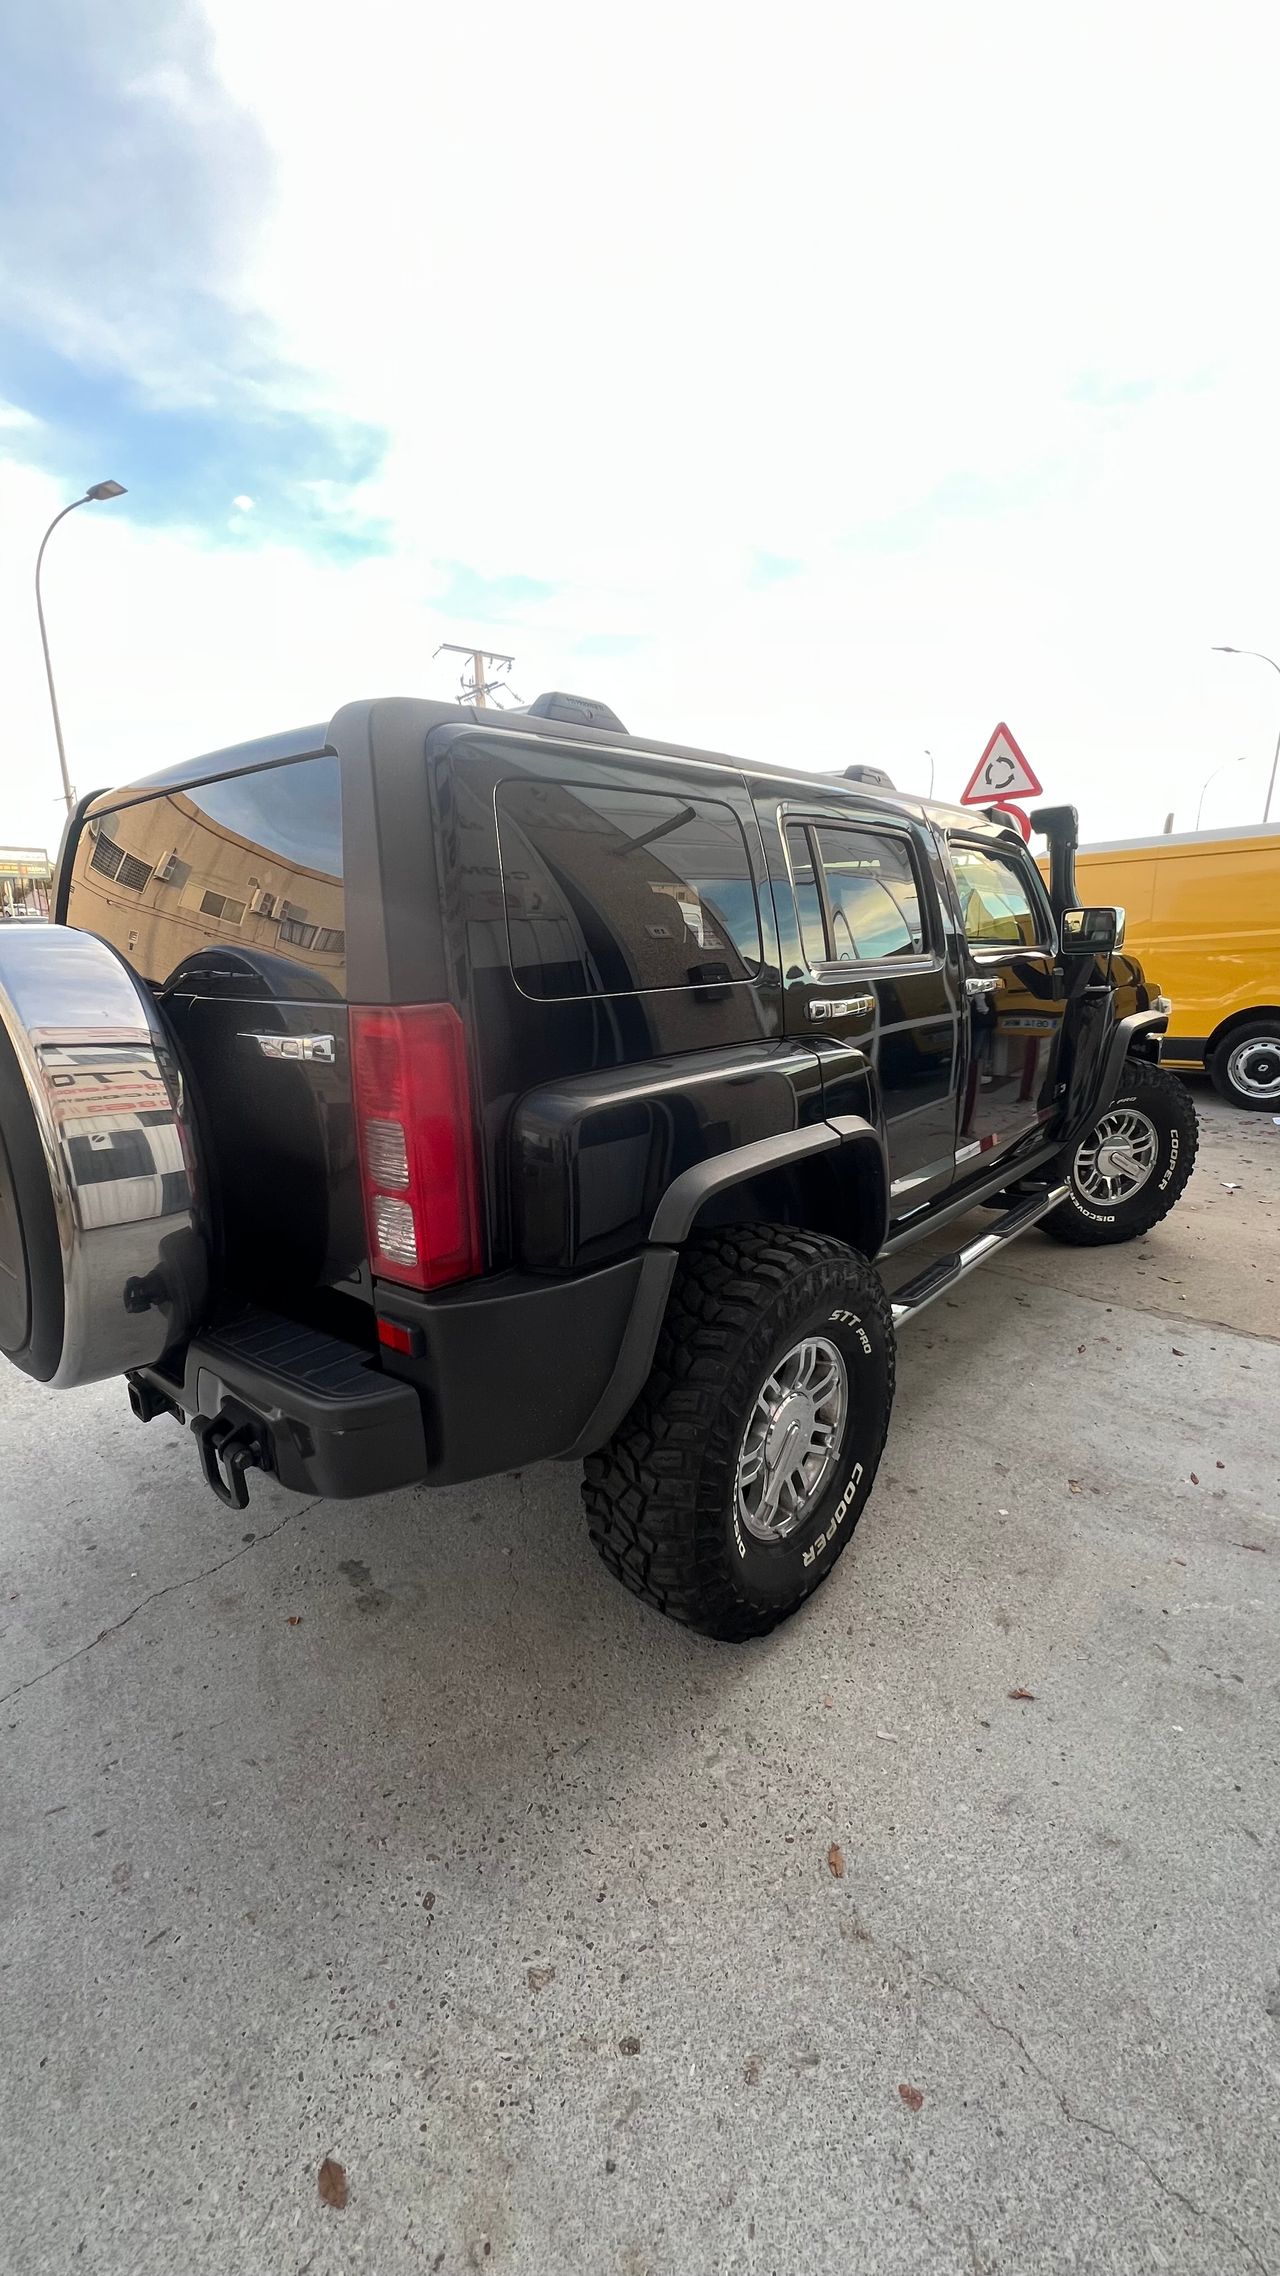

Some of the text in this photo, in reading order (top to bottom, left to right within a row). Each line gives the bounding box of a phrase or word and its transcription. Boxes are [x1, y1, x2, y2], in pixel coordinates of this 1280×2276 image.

[1158, 1129, 1179, 1191] COOPER
[828, 1309, 872, 1354] STT PRO
[802, 1462, 863, 1567] COOPER
